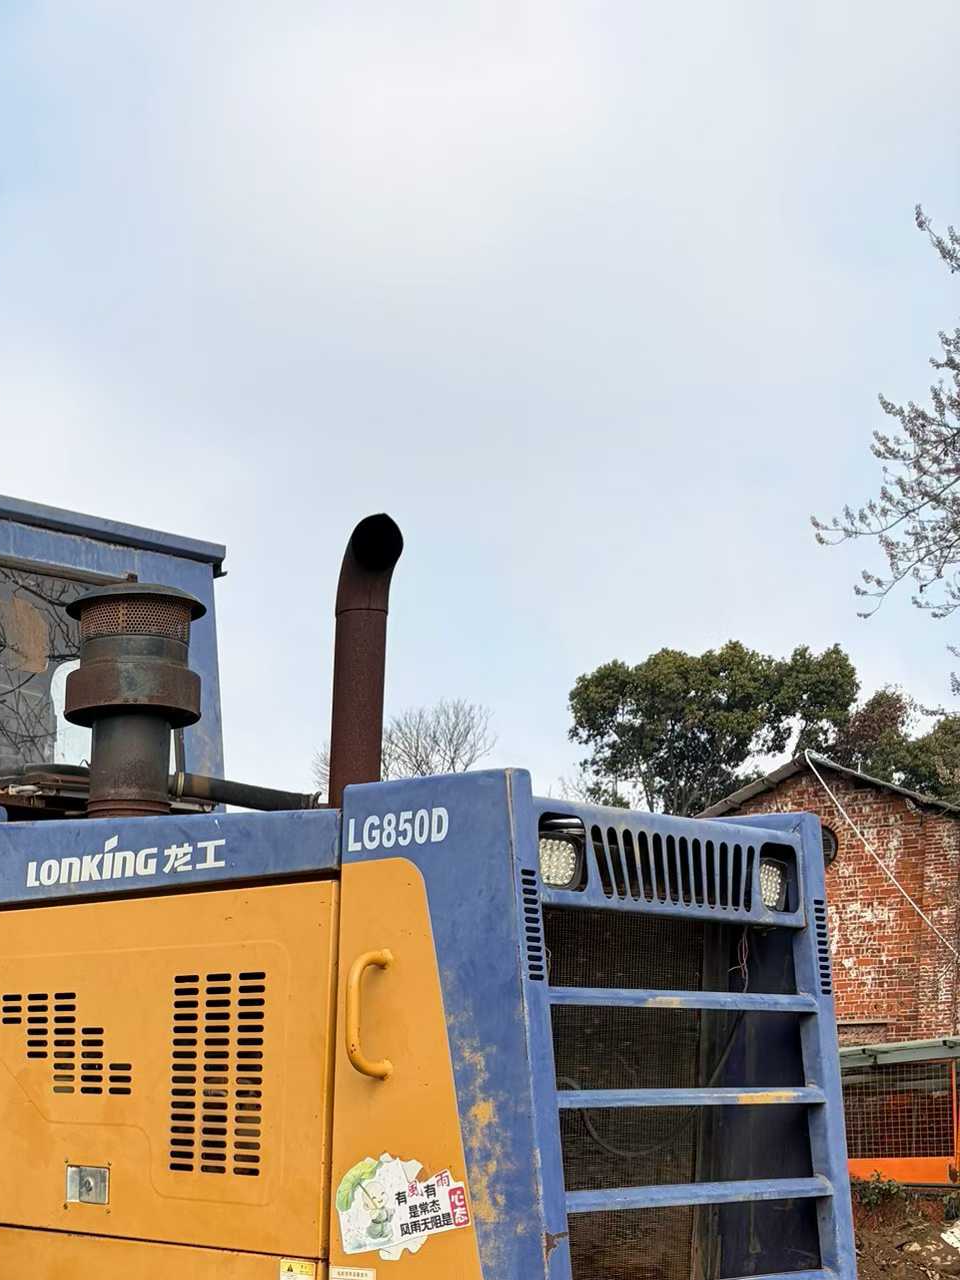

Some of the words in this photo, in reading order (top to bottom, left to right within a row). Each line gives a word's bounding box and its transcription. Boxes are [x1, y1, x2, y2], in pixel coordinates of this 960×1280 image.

[347, 806, 449, 852] LG850D
[26, 834, 159, 888] LONKING
[162, 838, 227, 875] 龙工
[400, 1212, 454, 1237] 风雨无阻是
[408, 1199, 442, 1219] 是常态
